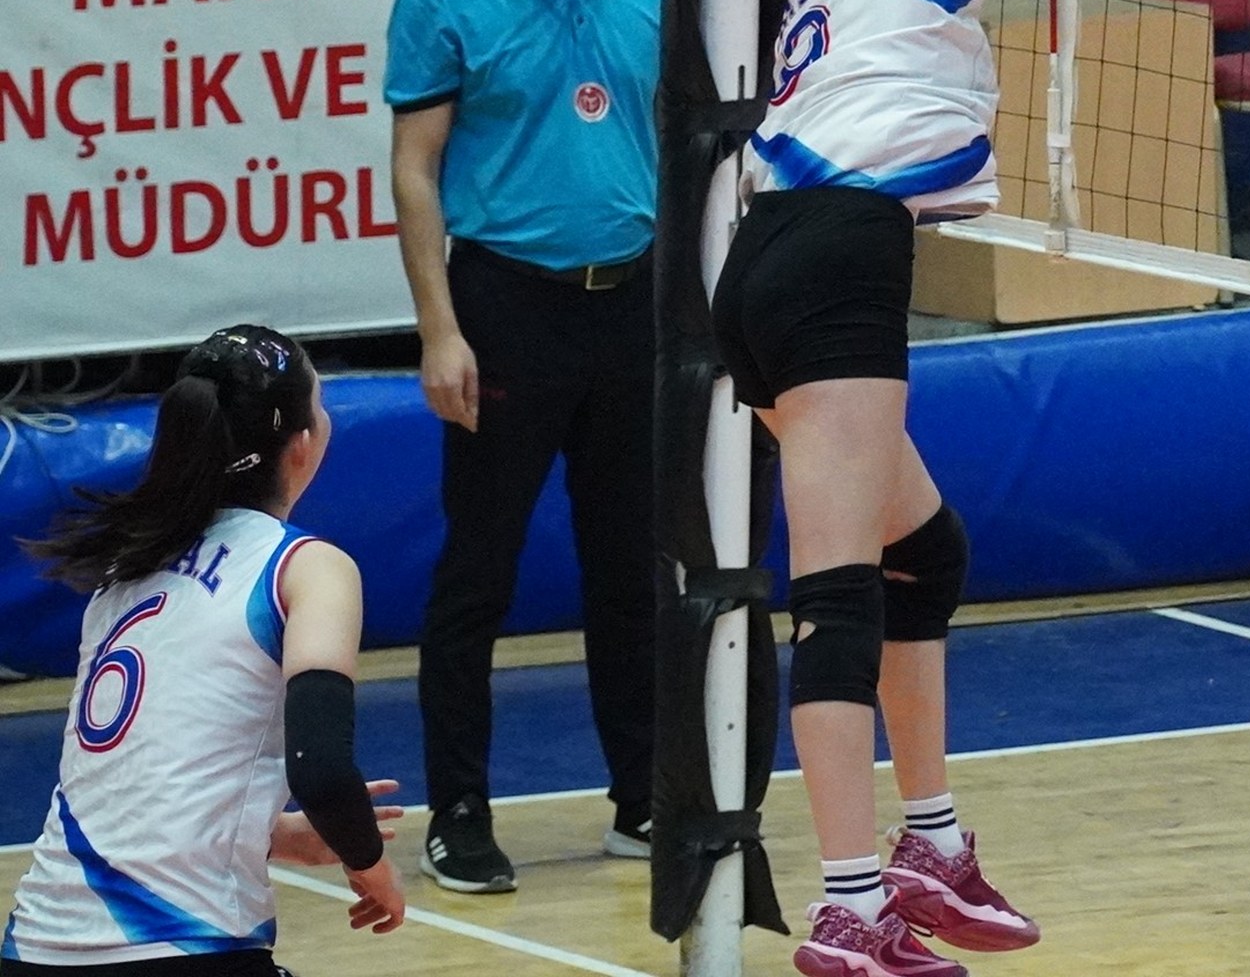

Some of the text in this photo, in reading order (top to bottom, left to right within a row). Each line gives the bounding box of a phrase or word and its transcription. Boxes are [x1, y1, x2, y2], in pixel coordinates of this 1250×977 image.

[0, 39, 368, 157] NÇLİK VE
[768, 5, 830, 107] 9
[23, 157, 400, 266] MÜDÜRL
[75, 591, 167, 753] 6
